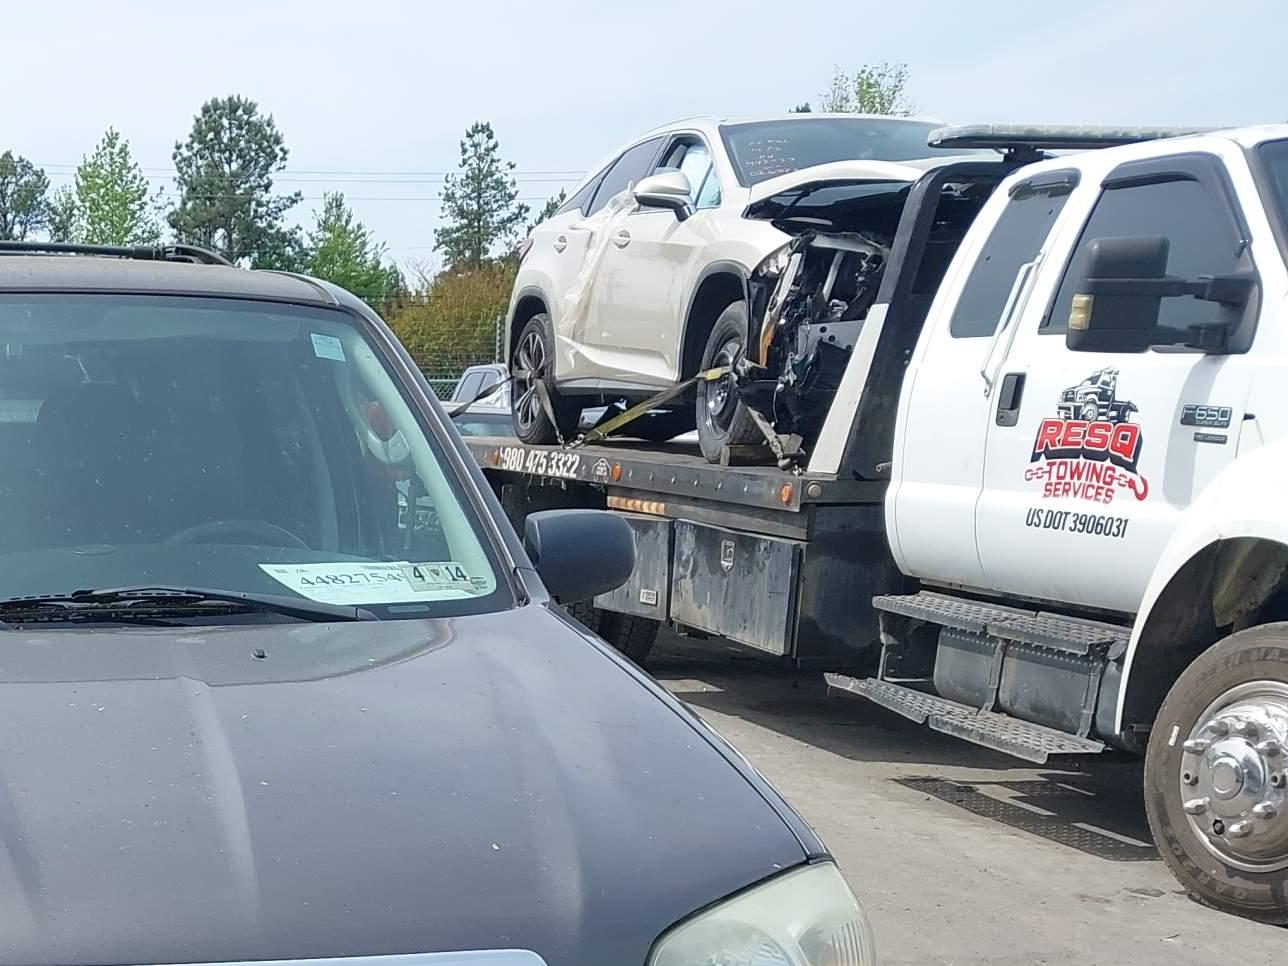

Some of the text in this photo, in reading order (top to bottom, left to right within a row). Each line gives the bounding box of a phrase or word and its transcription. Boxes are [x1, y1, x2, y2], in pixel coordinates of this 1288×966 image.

[1033, 418, 1142, 465] RESQ
[502, 447, 525, 471] 980
[526, 449, 548, 474] 475
[548, 452, 580, 479] 3322
[1045, 461, 1116, 486] TOWING
[1043, 481, 1115, 505] SERVICES
[1025, 507, 1130, 538] US DOT 3906031
[412, 566, 468, 582] 4 14
